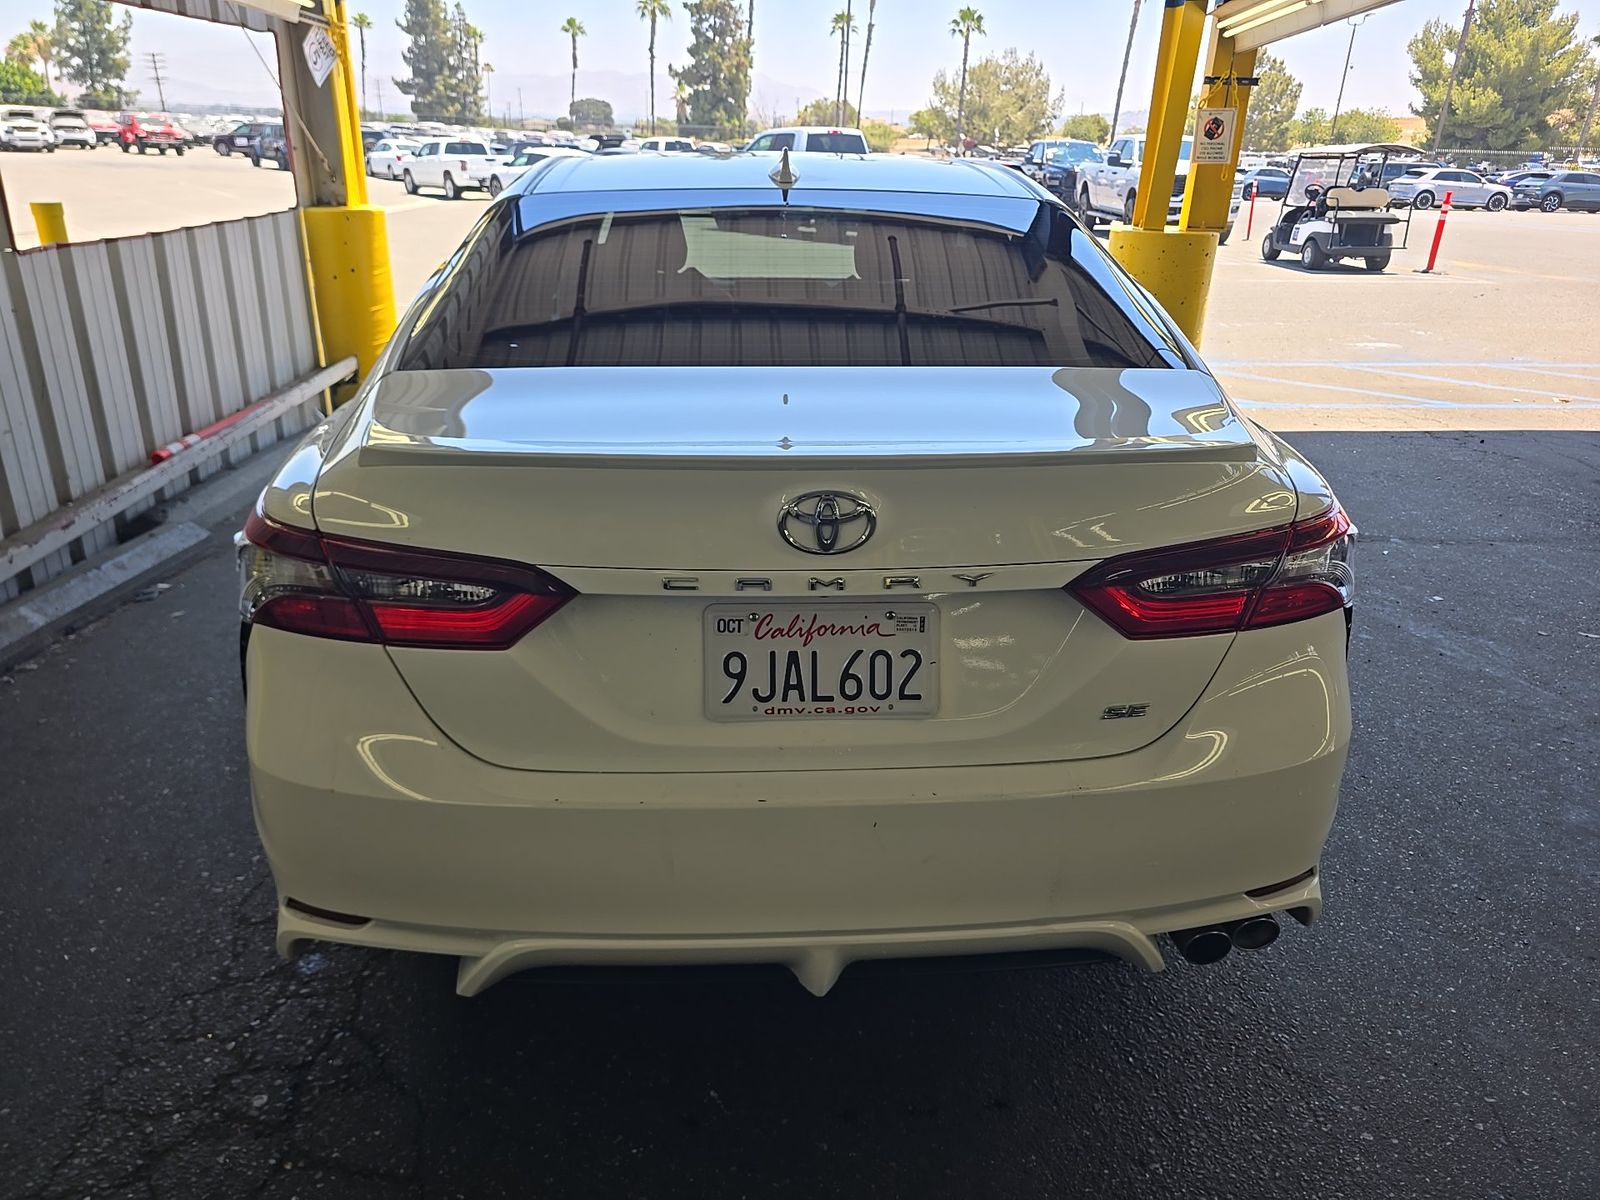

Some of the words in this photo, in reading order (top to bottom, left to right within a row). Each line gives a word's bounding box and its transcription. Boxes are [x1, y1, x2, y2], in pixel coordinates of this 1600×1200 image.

[661, 572, 996, 592] CAMRY
[716, 618, 744, 634] OCT
[754, 613, 897, 647] California
[721, 649, 923, 704] 9JAL602
[764, 705, 881, 715] dmv.ca.gov
[1102, 703, 1151, 720] SE
